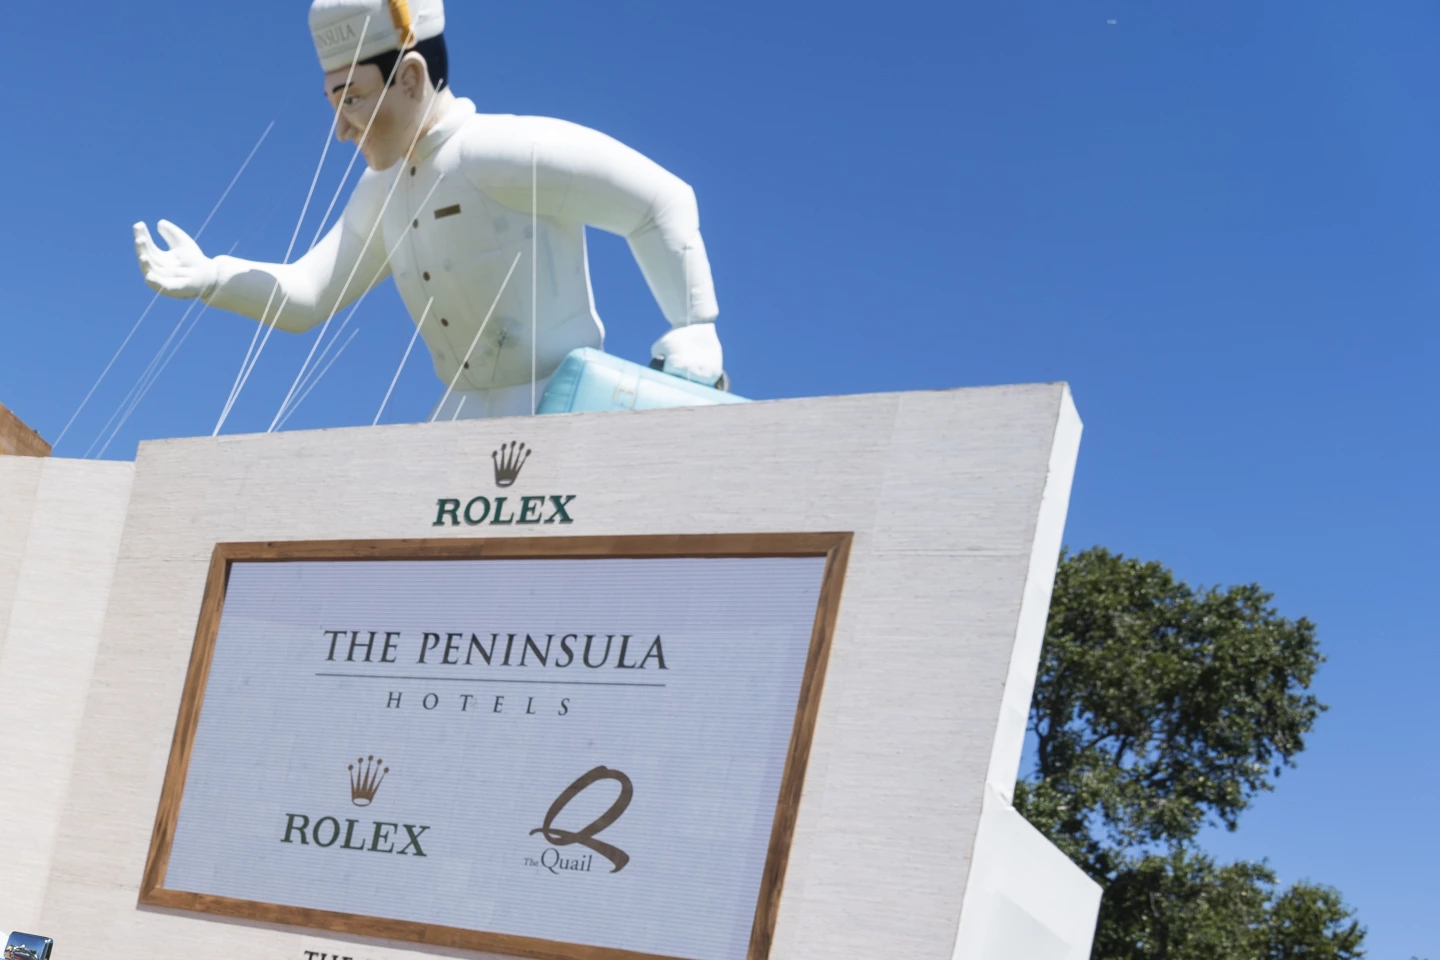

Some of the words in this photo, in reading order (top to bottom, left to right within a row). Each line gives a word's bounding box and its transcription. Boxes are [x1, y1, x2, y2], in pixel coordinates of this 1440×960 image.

[432, 494, 576, 527] ROLEX
[323, 630, 401, 664] THE
[415, 631, 670, 670] PENINSULA
[386, 690, 571, 717] HOTELS
[280, 812, 431, 858] ROLEX
[523, 857, 539, 867] The
[540, 847, 593, 875] Quail
